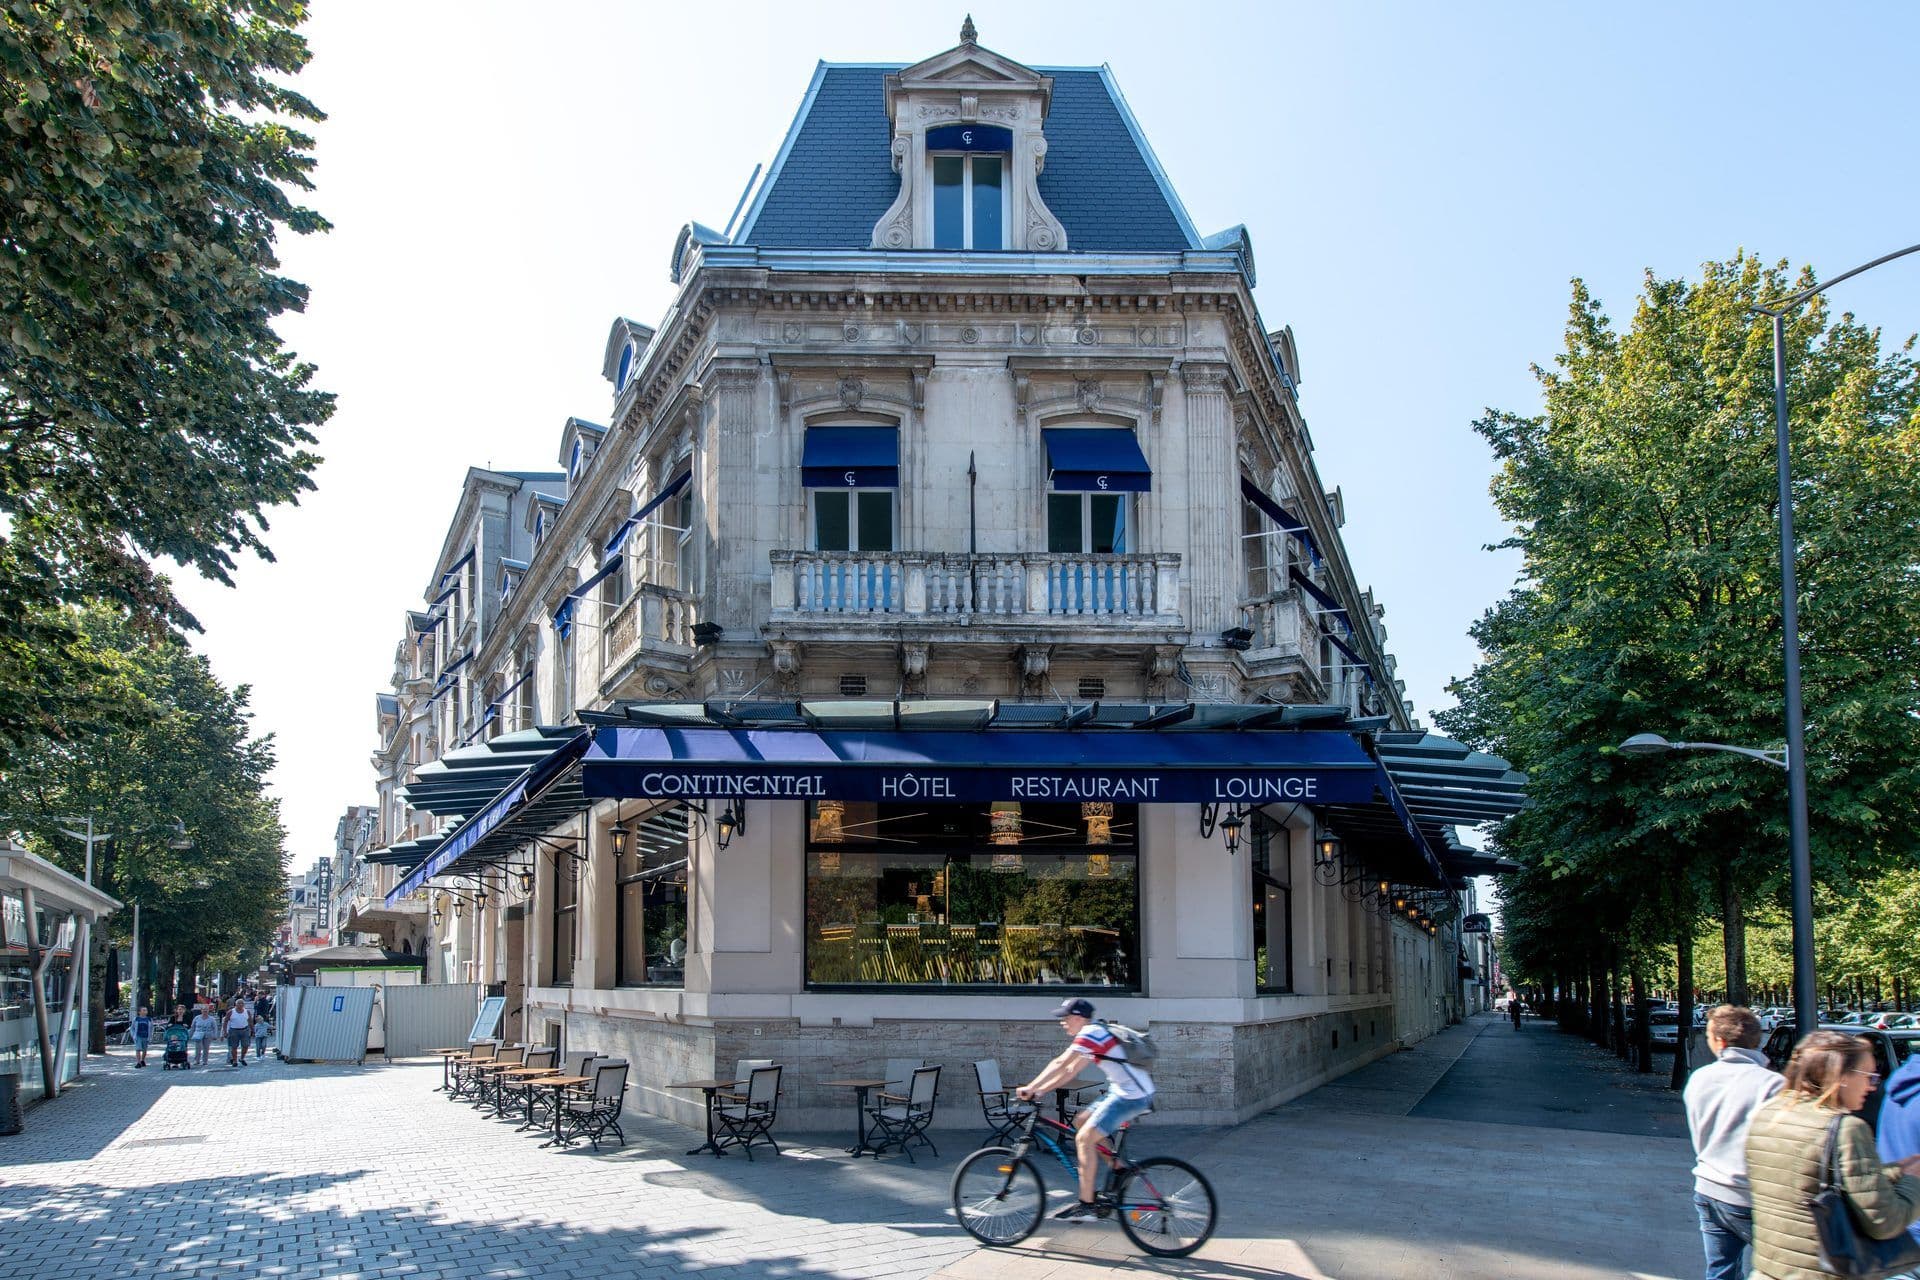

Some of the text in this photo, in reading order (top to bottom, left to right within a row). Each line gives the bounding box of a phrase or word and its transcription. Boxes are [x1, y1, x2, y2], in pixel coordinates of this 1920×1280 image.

[642, 772, 1317, 798] CONTINENTAL HÔTEL RESTAURANT LOUNGE
[320, 865, 329, 895] HOTEL
[319, 902, 328, 926] NORD
